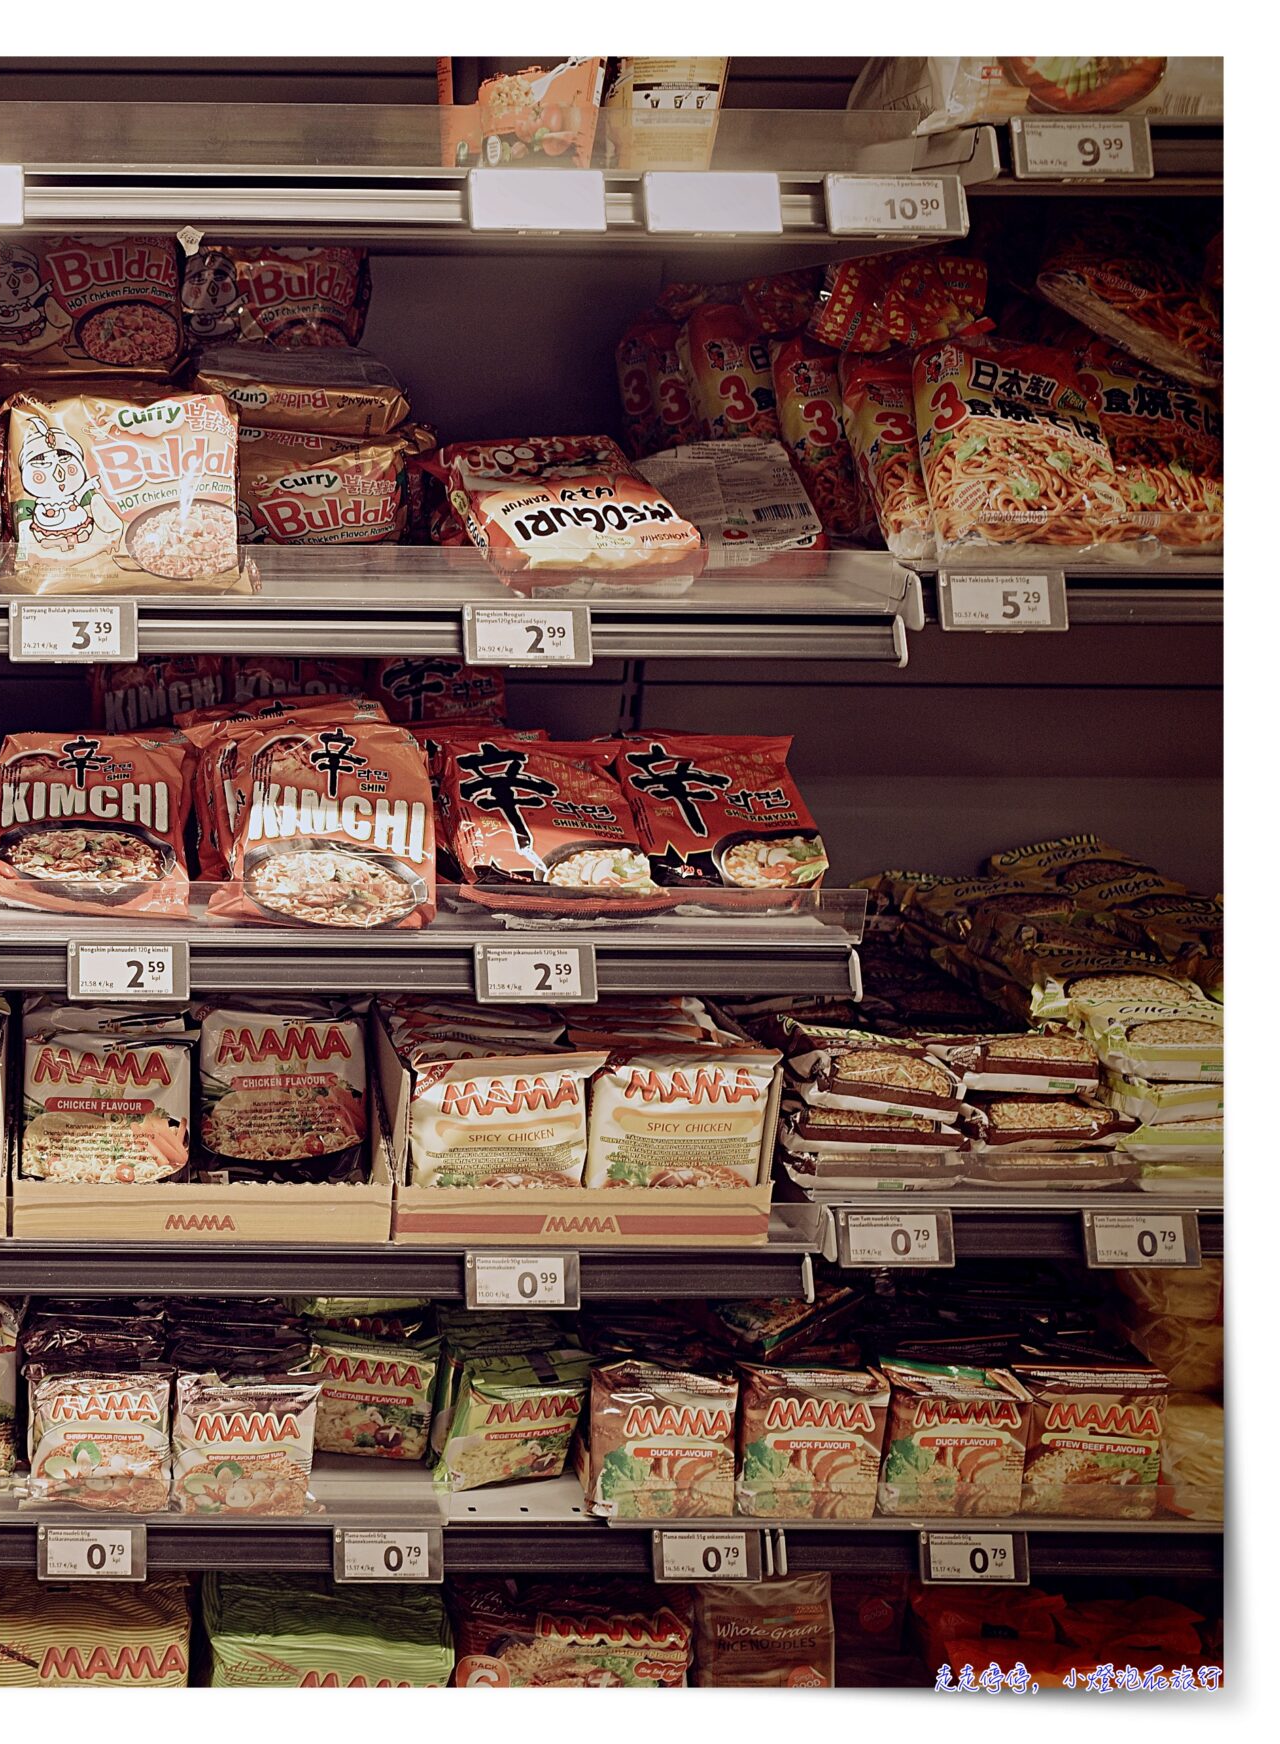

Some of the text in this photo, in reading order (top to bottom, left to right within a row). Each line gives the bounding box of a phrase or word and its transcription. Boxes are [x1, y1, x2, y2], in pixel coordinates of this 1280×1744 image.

[1077, 137, 1123, 166] 9 99
[884, 198, 939, 220] 10 90
[968, 357, 1058, 401] 日本製
[117, 400, 182, 428] Curry
[279, 471, 339, 489] Curry
[261, 499, 397, 538] Buldak
[515, 502, 674, 541] NEOGURI
[1001, 590, 1041, 619] 5 29
[72, 622, 112, 649] 3 39
[525, 626, 565, 653] 2 99
[58, 736, 111, 788] 辛
[310, 727, 367, 799] 辛
[356, 769, 389, 781] 라면
[106, 773, 130, 781] SHIN
[360, 783, 386, 792] SHIN
[624, 742, 732, 838] 辛
[0, 781, 169, 833] KIMCHI
[456, 741, 559, 856] 辛
[551, 799, 616, 822] 라면
[726, 788, 790, 813] 라면
[248, 780, 426, 863] KIMCHI
[553, 818, 625, 834] SHIN RAMYUN
[725, 808, 797, 821] SHIN RAMYUN
[127, 960, 144, 988] 2
[148, 961, 164, 972] 59
[533, 963, 572, 990] 2 59
[218, 1025, 352, 1064] MAMA
[31, 1047, 173, 1087] MAMA
[242, 1076, 326, 1088] CHICKEN FLAVOUR
[440, 1074, 580, 1117] MAMA
[623, 1067, 761, 1105] MAMA
[57, 1099, 142, 1111] CHICKEN FLAVOUR
[468, 1127, 555, 1144] SPICY CHICKEN
[647, 1121, 733, 1133] SPICY CHICKEN
[890, 1228, 930, 1256] 0 79
[1137, 1230, 1176, 1257] 0 79
[518, 1272, 557, 1298] 0 99
[194, 1412, 302, 1442] MAMA
[624, 1405, 732, 1439] MAMA
[1044, 1401, 1163, 1436] MAMA
[650, 1448, 713, 1458] DUCK FLAVOUR
[789, 1441, 851, 1450] DUCK FLAVOUR
[935, 1438, 997, 1447] DUCK FLAVOUR
[1055, 1441, 1146, 1455] STEW BEEF FLAVOUR
[86, 1543, 124, 1570] 0 79
[383, 1545, 422, 1573] 0 79
[702, 1546, 740, 1573] 0 79
[969, 1547, 1007, 1574] 0 79
[471, 1661, 499, 1671] PACK
